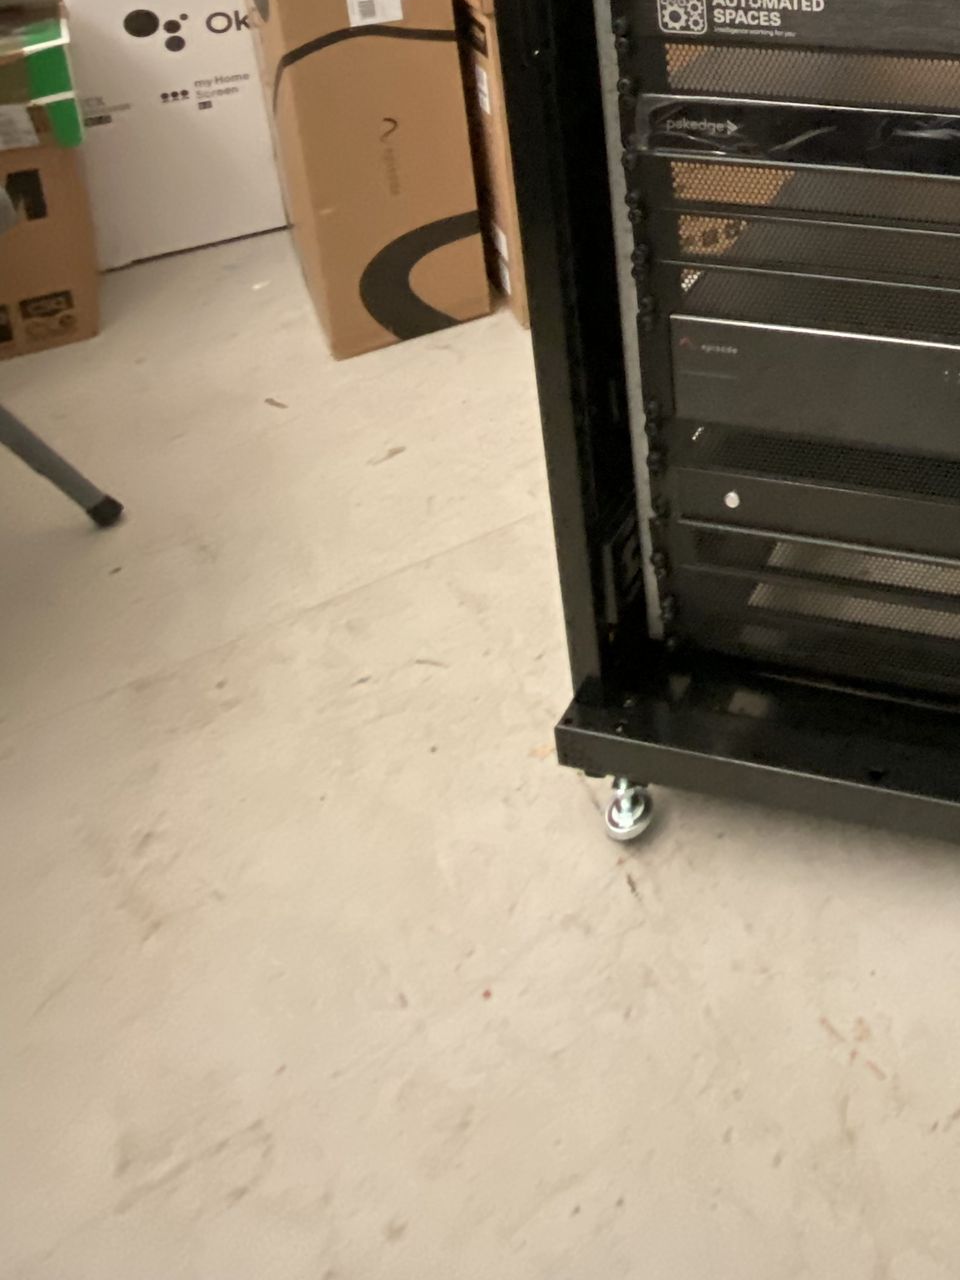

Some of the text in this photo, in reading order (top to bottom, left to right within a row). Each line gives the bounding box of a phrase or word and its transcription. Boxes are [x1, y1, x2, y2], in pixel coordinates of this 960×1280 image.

[206, 10, 250, 34] Ok
[713, 9, 781, 27] SPACES
[214, 73, 250, 84] Home
